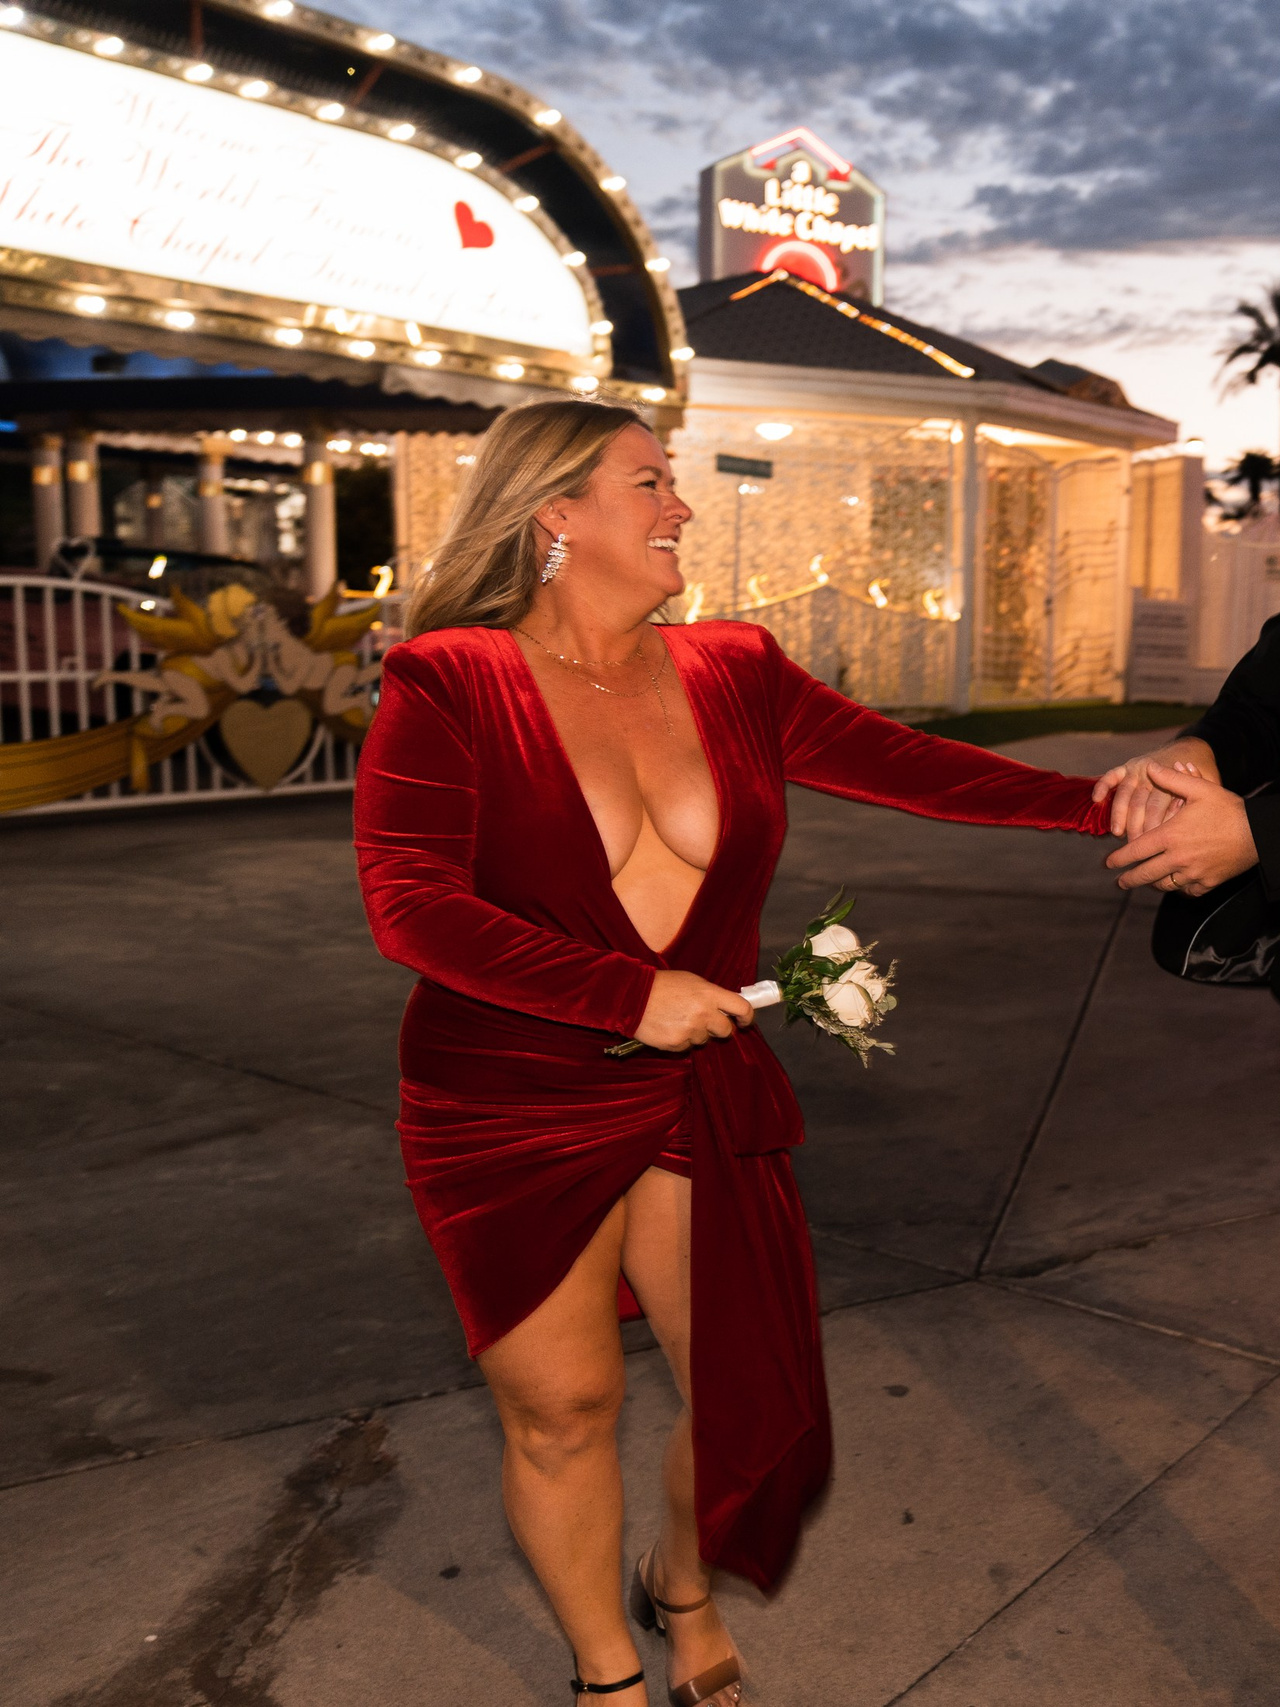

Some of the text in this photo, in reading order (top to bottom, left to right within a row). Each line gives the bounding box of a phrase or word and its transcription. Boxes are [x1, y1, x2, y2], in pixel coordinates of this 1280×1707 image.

[24, 117, 92, 167] The
[121, 141, 262, 211] World
[718, 198, 881, 254] White Chapel
[764, 177, 840, 217] Little
[121, 204, 274, 275] Chapel
